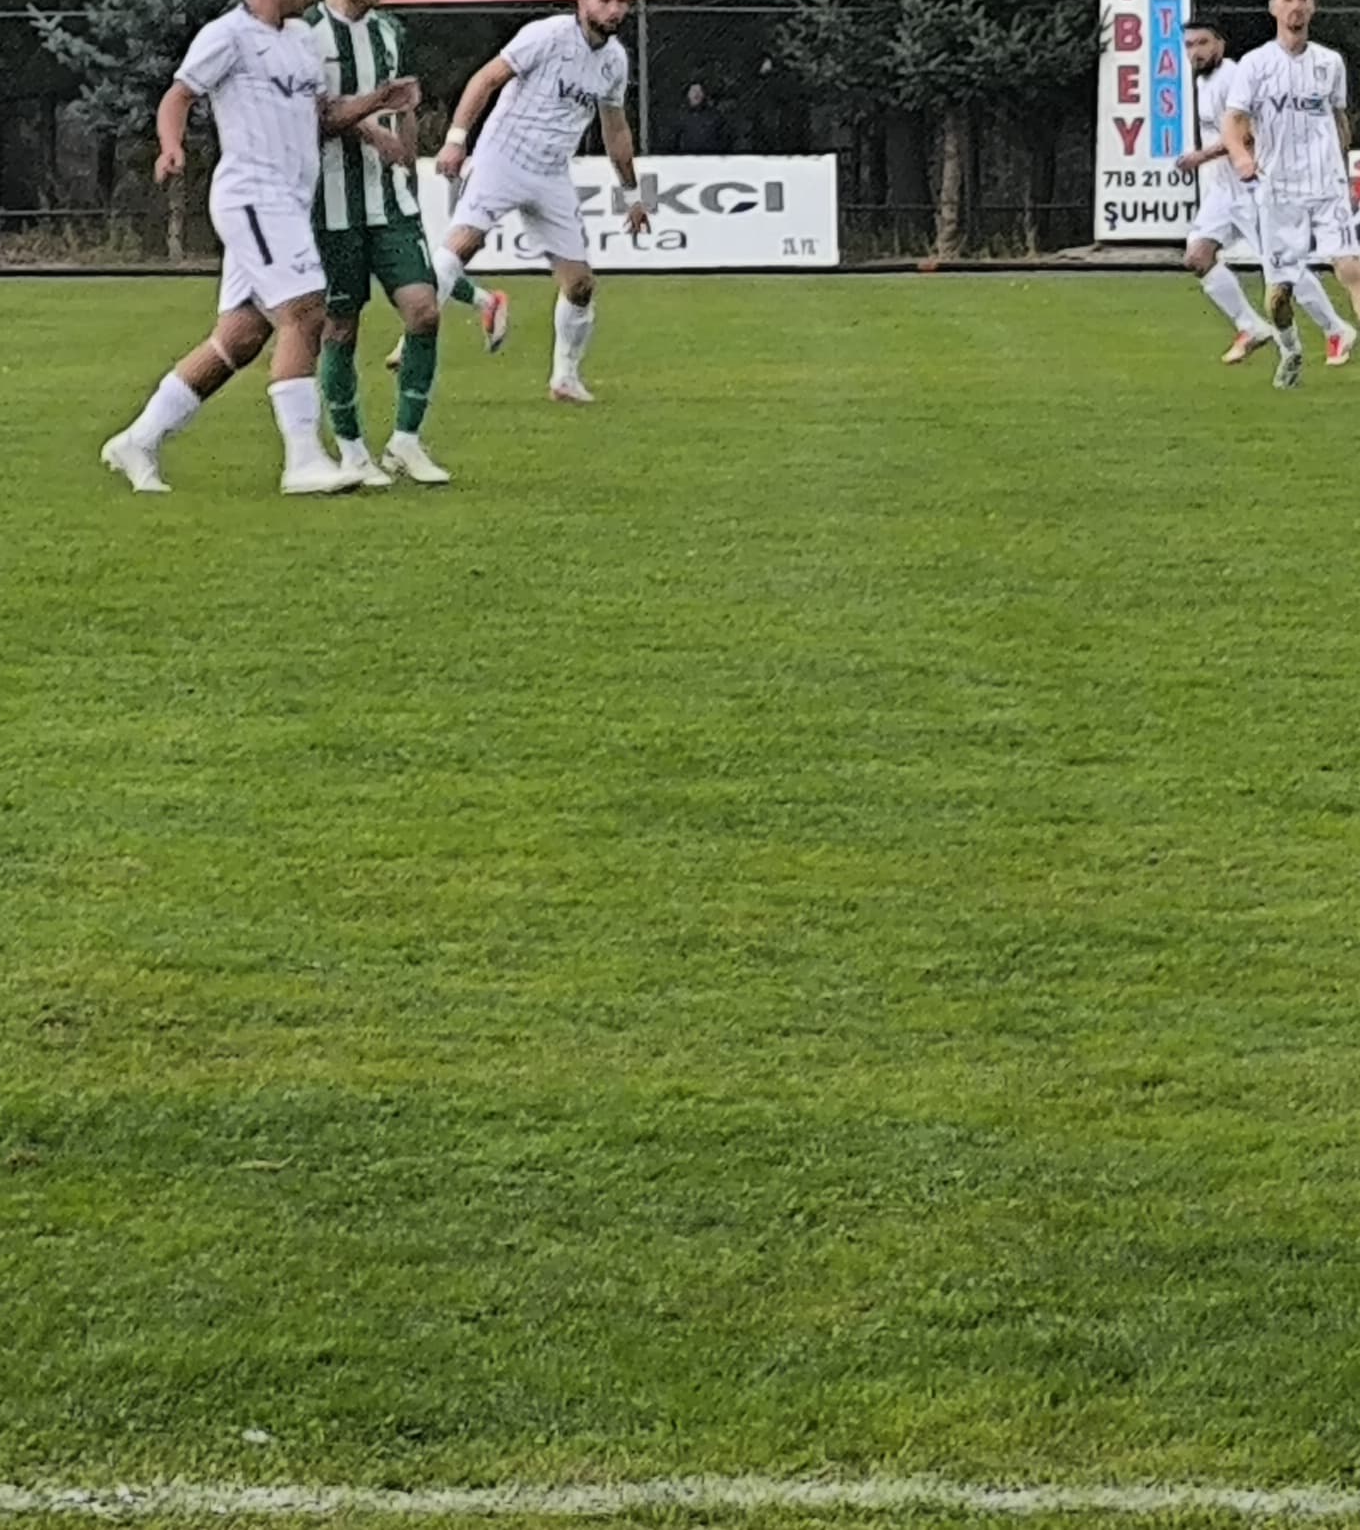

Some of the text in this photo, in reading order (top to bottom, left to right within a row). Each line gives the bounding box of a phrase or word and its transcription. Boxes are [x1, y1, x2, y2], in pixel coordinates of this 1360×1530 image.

[1103, 171, 1136, 187] 718
[1142, 170, 1161, 187] 21
[1104, 201, 1195, 231] ŞUHUT
